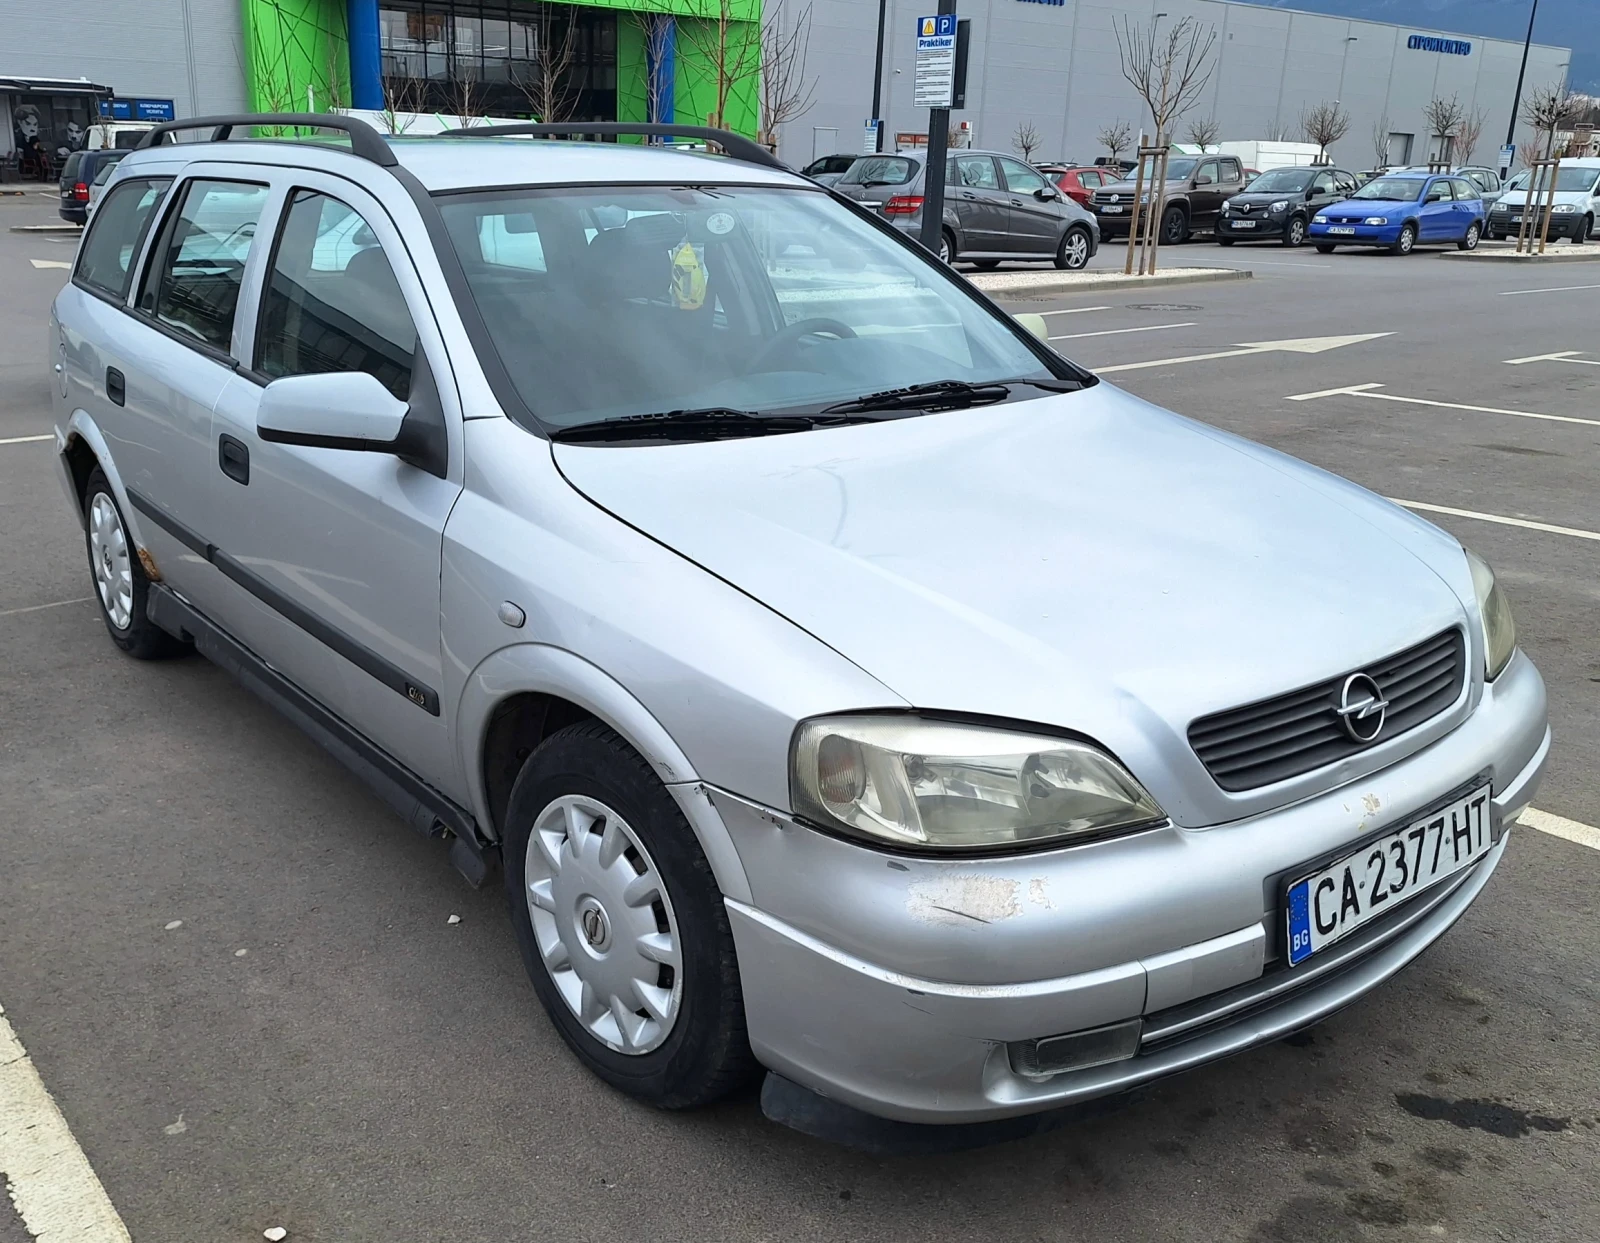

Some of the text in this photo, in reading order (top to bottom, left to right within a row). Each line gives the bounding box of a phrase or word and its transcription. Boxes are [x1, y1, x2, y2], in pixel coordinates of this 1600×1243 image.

[941, 19, 949, 32] P
[919, 38, 952, 48] Praktiker
[1407, 34, 1471, 56] СТРОИТЕЛСТВО
[1313, 794, 1486, 935] CA 2377 HT
[1293, 929, 1309, 951] BG
